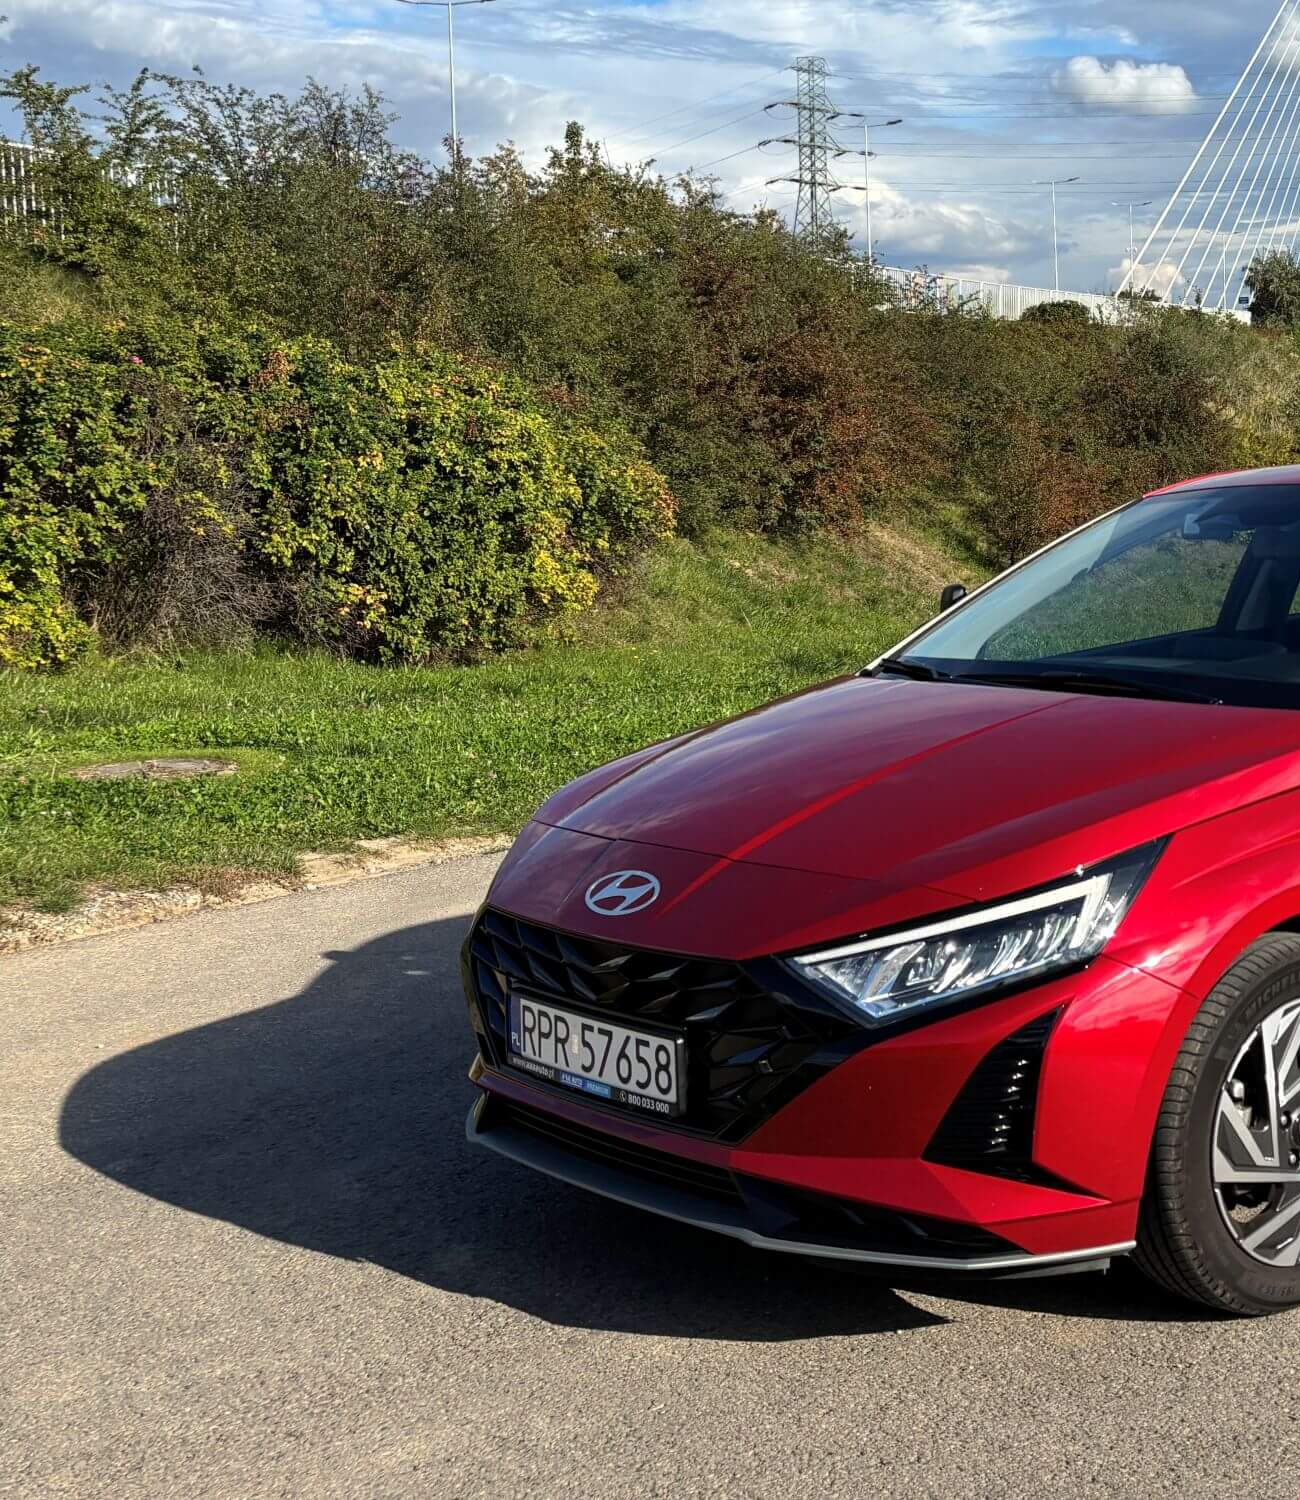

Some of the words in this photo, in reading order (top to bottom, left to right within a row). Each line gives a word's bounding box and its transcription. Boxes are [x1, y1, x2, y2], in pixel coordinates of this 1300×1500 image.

[511, 1032, 521, 1047] PL
[522, 1004, 570, 1068] RPR
[580, 1023, 673, 1095] 57658
[628, 1094, 641, 1106] 800
[642, 1098, 655, 1110] 033
[656, 1102, 670, 1114] 000
